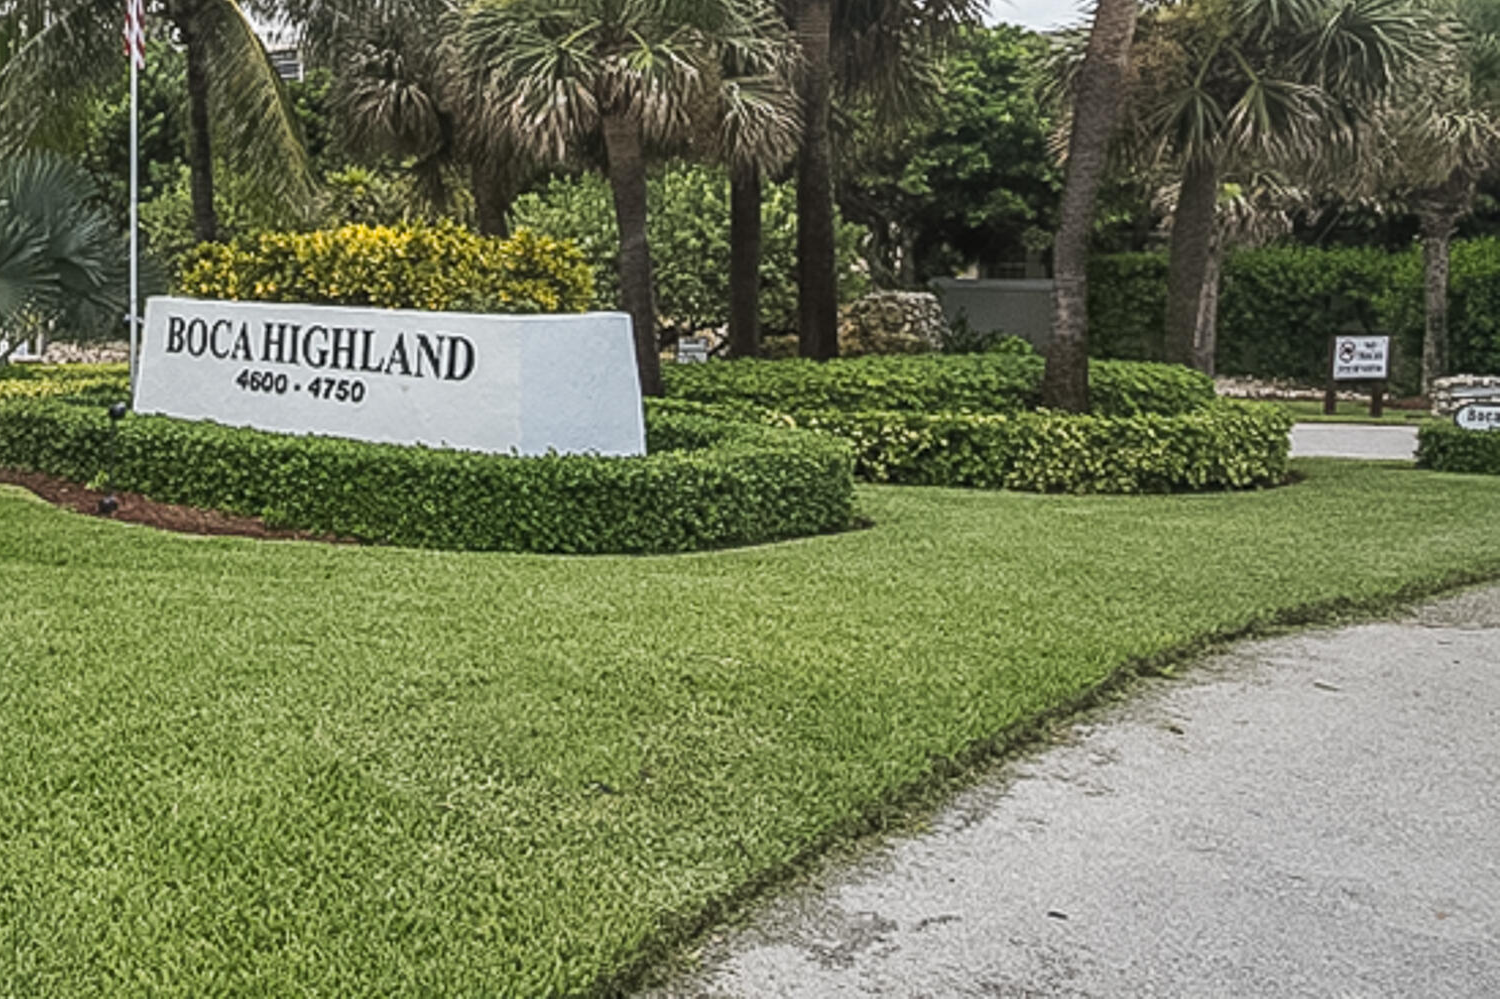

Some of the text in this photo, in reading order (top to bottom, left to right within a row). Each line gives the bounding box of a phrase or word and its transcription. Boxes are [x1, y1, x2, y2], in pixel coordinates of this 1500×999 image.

[166, 316, 476, 382] BOCA HIGHLAND
[235, 368, 288, 395] 4600
[307, 376, 366, 403] 4750
